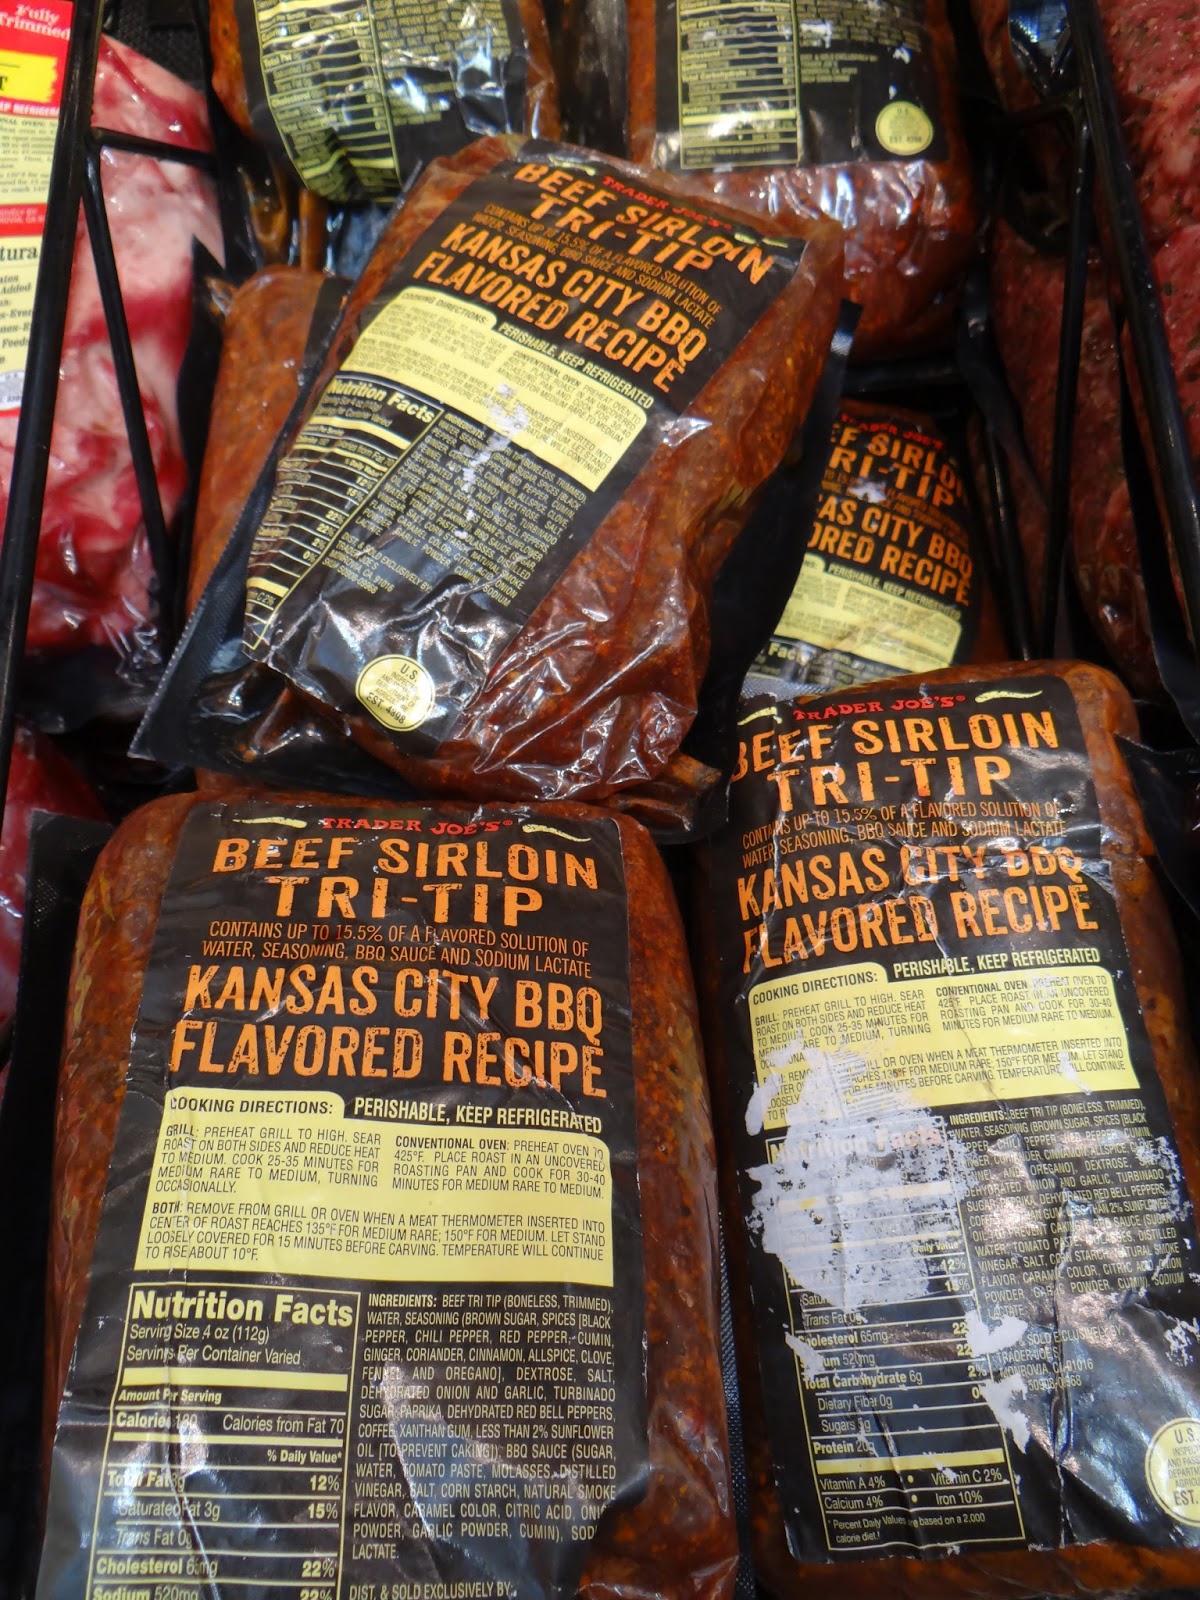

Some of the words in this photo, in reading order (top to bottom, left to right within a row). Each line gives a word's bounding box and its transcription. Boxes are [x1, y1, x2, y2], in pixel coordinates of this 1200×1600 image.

[15, 4, 59, 26] Fully
[602, 176, 668, 209] TRADER
[513, 162, 618, 209] BEEF
[615, 204, 775, 286] SIRLOIN
[530, 192, 716, 273] TRI-TIP
[441, 223, 567, 289] KANSAS
[562, 268, 644, 318] CITY
[636, 301, 709, 363] BBQ
[412, 252, 569, 331] FLAVORED
[565, 310, 687, 394] RECIPE
[497, 323, 557, 358] PERISHABLE,
[557, 346, 587, 370] KEEP
[581, 359, 654, 410] REFRIGERATED
[327, 377, 388, 402] Nutrition
[386, 393, 434, 424] Facts
[829, 446, 954, 507] RI-TIP
[861, 505, 925, 549] CITY
[928, 532, 974, 581] BBQ
[880, 544, 970, 606] RECIPE
[882, 582, 904, 596] KEEP
[792, 701, 885, 721] TRADER
[851, 711, 1060, 756] SIRLOIN
[766, 756, 1012, 812] TRI-TIP
[322, 816, 422, 833] TRADER
[212, 836, 359, 874] BEEF
[376, 837, 598, 890] SIRLOIN
[736, 846, 890, 921] KANSAS
[900, 844, 986, 886] CITY
[267, 875, 544, 927] TRI-TIP
[209, 921, 283, 939] CONTAINS
[287, 923, 308, 939] UP
[311, 924, 332, 941] TO
[335, 924, 382, 943] 15.5%
[388, 926, 407, 943] OF
[410, 927, 421, 943] A
[425, 926, 496, 947] FLAVORED
[500, 931, 567, 954] SOLUTION
[572, 940, 590, 957] OF
[742, 896, 939, 975] FLAVORED
[950, 884, 1099, 940] RECIPE
[202, 939, 255, 960] WATER,
[261, 940, 350, 961] SEASONING,
[355, 943, 386, 962] BBQ
[390, 943, 437, 963] SAUCE
[440, 946, 471, 965] AND
[475, 948, 531, 972] SODIUM
[535, 955, 592, 979] LACTATE
[892, 955, 975, 978] PERISHABLE,
[977, 952, 1009, 971] KEEP
[1011, 948, 1101, 969] REFRIGERATED
[753, 983, 799, 1005] COOKING
[802, 971, 878, 993] DIRECTIONS:
[182, 963, 379, 1016] KANSAS
[393, 967, 499, 1022] CITY
[514, 980, 603, 1046] BBQ
[168, 1019, 425, 1080] FLAVORED
[442, 1030, 607, 1098] RECIPE
[170, 1097, 234, 1112] COOKING
[239, 1100, 333, 1114] DIRECTIONS:
[354, 1097, 450, 1125] PERISHABLE,
[456, 1104, 493, 1124] KEEP
[497, 1107, 602, 1134] REFRIGERATED
[166, 1124, 199, 1137] GRILL:
[203, 1126, 255, 1138] PREHEAT
[259, 1127, 293, 1139] GRILL
[298, 1129, 312, 1139] TO
[317, 1129, 348, 1142] HIGH.
[353, 1132, 381, 1145] SEAR
[395, 1136, 475, 1150] CONVENTIONAL
[479, 1138, 510, 1151] OVEN:
[513, 1140, 560, 1155] PREHEAT
[562, 1143, 589, 1157] OVEN
[131, 1290, 264, 1322] Nutrition
[274, 1294, 353, 1328] Facts
[368, 1293, 438, 1308] INGREDIENTS:
[442, 1294, 466, 1307] BEEF
[467, 1294, 484, 1308] TRI
[486, 1294, 502, 1308] TIP
[503, 1295, 560, 1310] (BONELESS,
[563, 1296, 614, 1314] TRIMMED),
[367, 1311, 403, 1326] WATER,
[404, 1311, 460, 1326] SEASONING
[461, 1312, 501, 1328] (BROWN
[503, 1312, 540, 1327] SUGAR,
[541, 1313, 576, 1327] SPICES
[129, 1324, 172, 1342] Serving
[174, 1324, 200, 1338] Size
[214, 1329, 229, 1339] oz
[232, 1326, 270, 1345] (112g)
[202, 1344, 262, 1363] Container
[265, 1349, 300, 1365] Varied
[363, 1347, 404, 1362] GINGER,
[406, 1347, 467, 1363] CORIANDER,
[468, 1347, 527, 1364] CINNAMON,
[528, 1348, 579, 1364] ALLSPICE,
[580, 1350, 615, 1366] CLOVE,
[118, 1389, 160, 1402] Amount
[181, 1389, 222, 1405] Serving
[223, 1414, 273, 1433] Calories
[276, 1418, 304, 1433] from
[307, 1417, 326, 1433] Fat
[329, 1418, 344, 1435] 70
[267, 1450, 277, 1462] %
[280, 1450, 307, 1464] Daily
[310, 1475, 340, 1491] 12%
[819, 1478, 857, 1490] Vitamin
[858, 1477, 867, 1489] A
[868, 1476, 886, 1488] 4%
[972, 1469, 982, 1482] C
[984, 1468, 1003, 1481] 2%
[824, 1495, 864, 1510] Calcium
[866, 1496, 884, 1508] 4%
[935, 1493, 957, 1505] Iron
[958, 1490, 983, 1503] 10%
[1173, 1490, 1199, 1506] EST.
[308, 1504, 338, 1519] 15%
[153, 1529, 174, 1546] Fat
[96, 1558, 183, 1575] Cholesterol
[301, 1561, 336, 1577] 22%
[350, 1585, 377, 1600] DIST.
[380, 1586, 390, 1599] &
[391, 1584, 421, 1600] SOLD
[423, 1581, 494, 1598] EXCLUSIVELY
